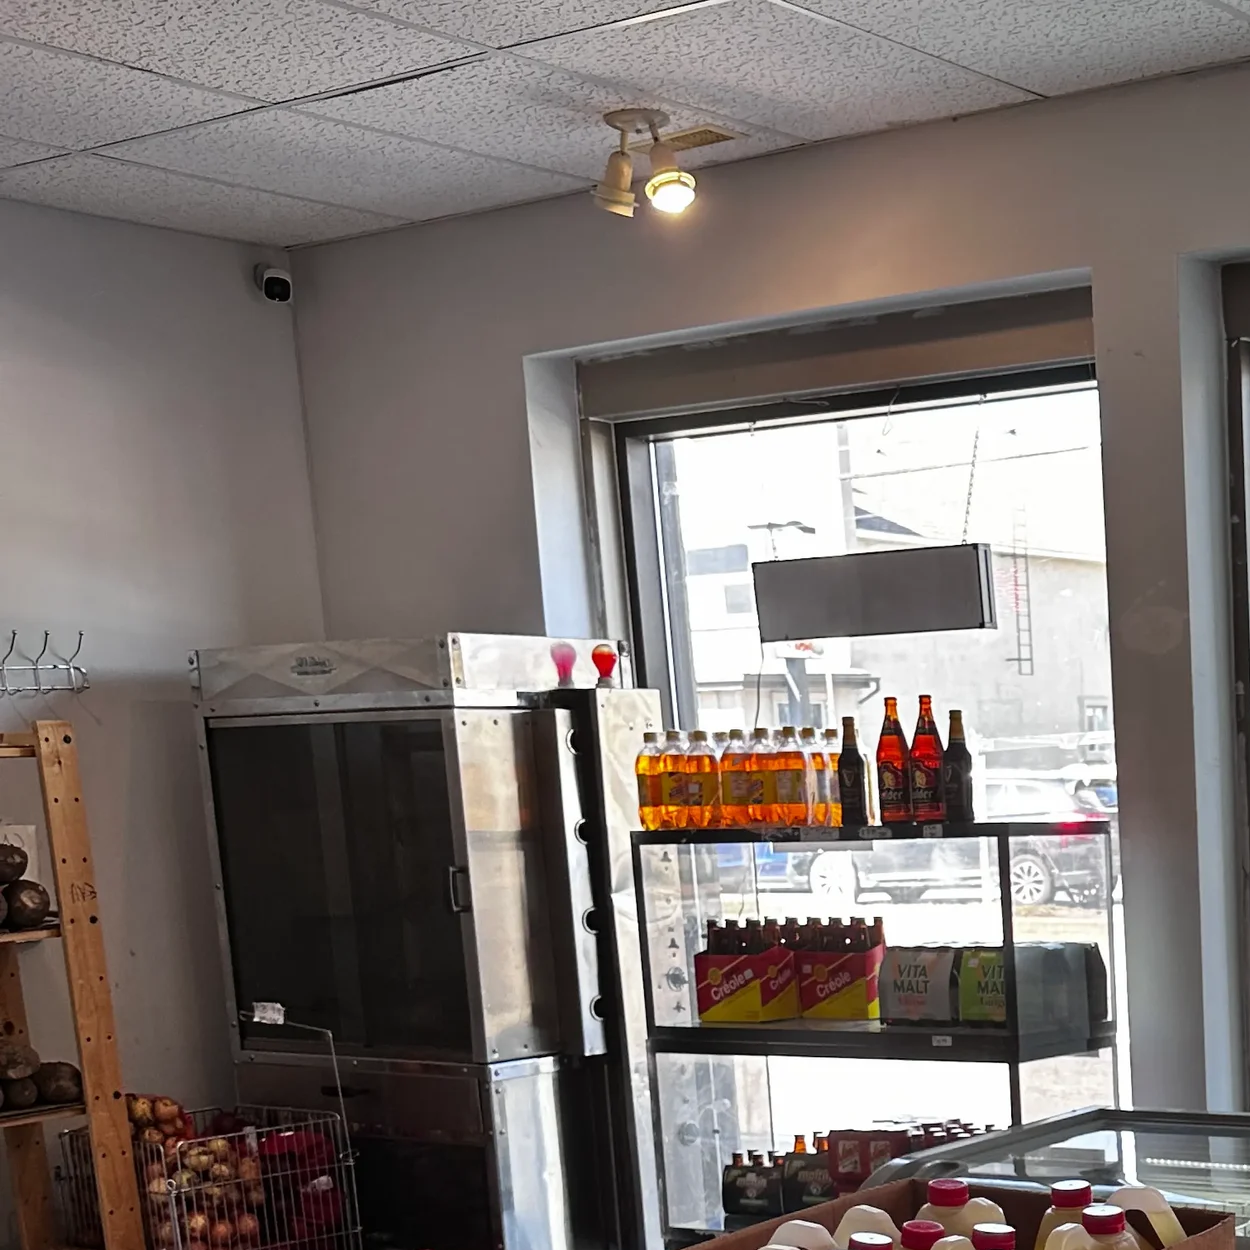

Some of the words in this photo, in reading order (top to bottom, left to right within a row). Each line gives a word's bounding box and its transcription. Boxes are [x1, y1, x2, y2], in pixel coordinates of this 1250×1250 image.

[896, 964, 928, 980] VITA
[711, 973, 746, 1001] Créole
[815, 971, 852, 998] Créole
[893, 980, 930, 995] MALT
